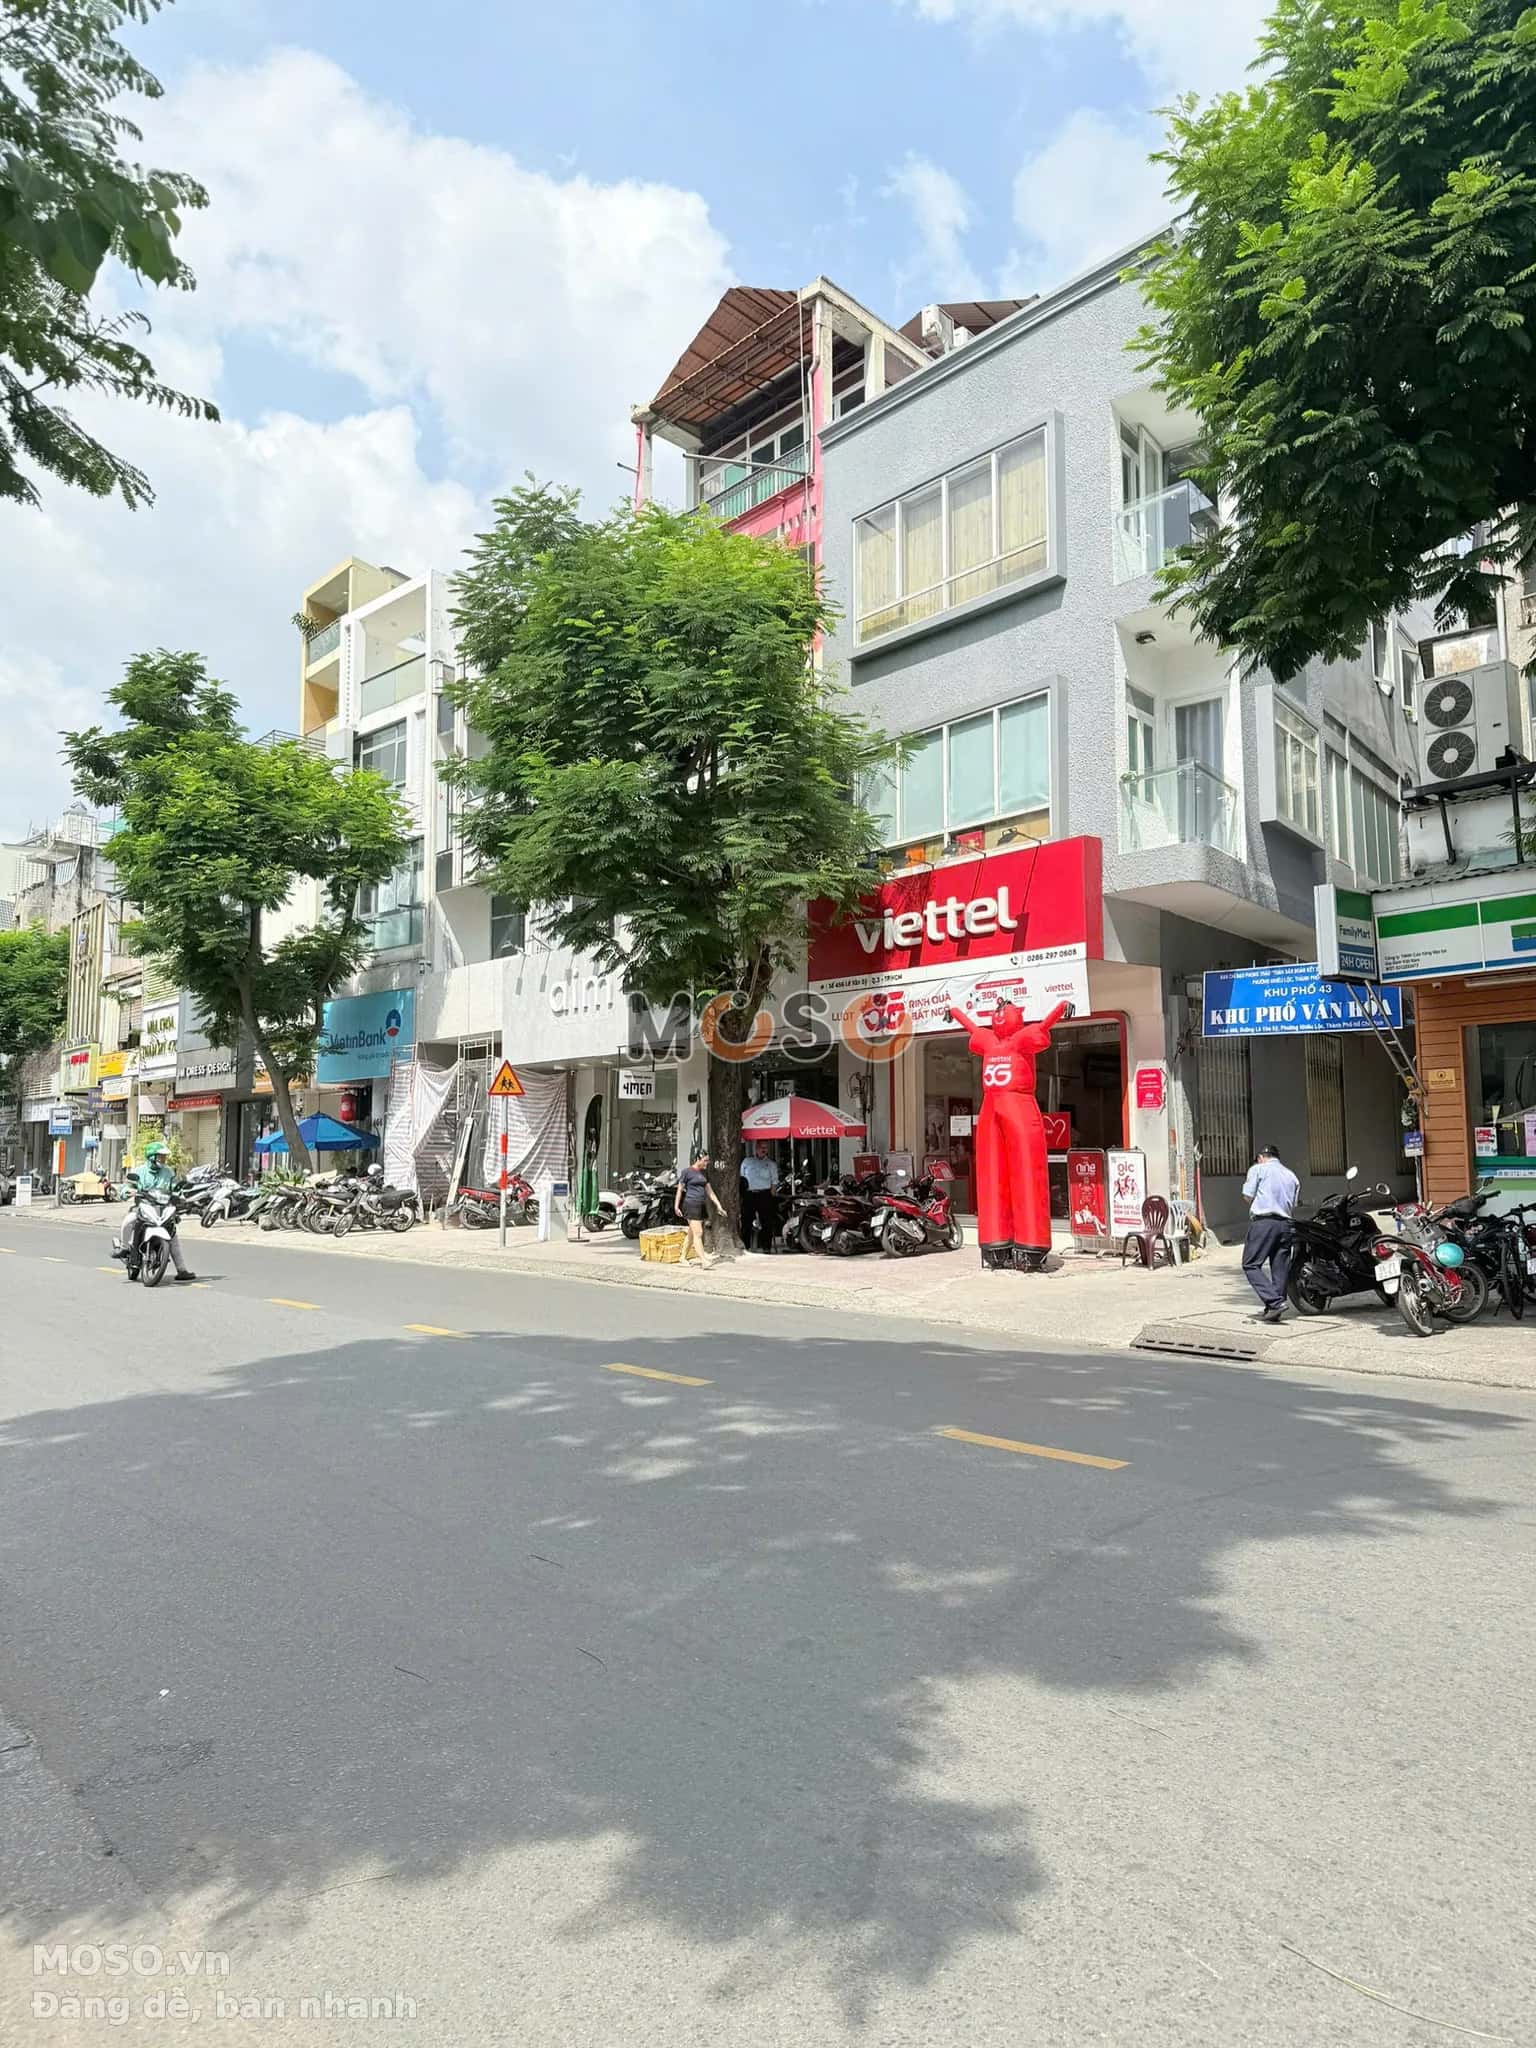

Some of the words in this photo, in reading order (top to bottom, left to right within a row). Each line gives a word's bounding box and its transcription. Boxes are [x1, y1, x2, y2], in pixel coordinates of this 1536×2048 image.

[854, 886, 1018, 954] viettel
[1339, 924, 1371, 940] FamilyMart
[1045, 952, 1058, 960] 297
[1340, 954, 1355, 966] 24H
[1355, 957, 1374, 971] OPEN
[1012, 986, 1028, 996] 918
[1044, 983, 1074, 993] viettel
[1264, 987, 1288, 998] KHU
[1291, 981, 1316, 995] PHỐ
[1319, 984, 1333, 994] 43
[1210, 1007, 1250, 1026] KHU
[1256, 998, 1297, 1024] PHỐ
[1300, 1000, 1344, 1021] VĂN
[983, 1063, 1013, 1087] 5G
[799, 1125, 838, 1136] viettel
